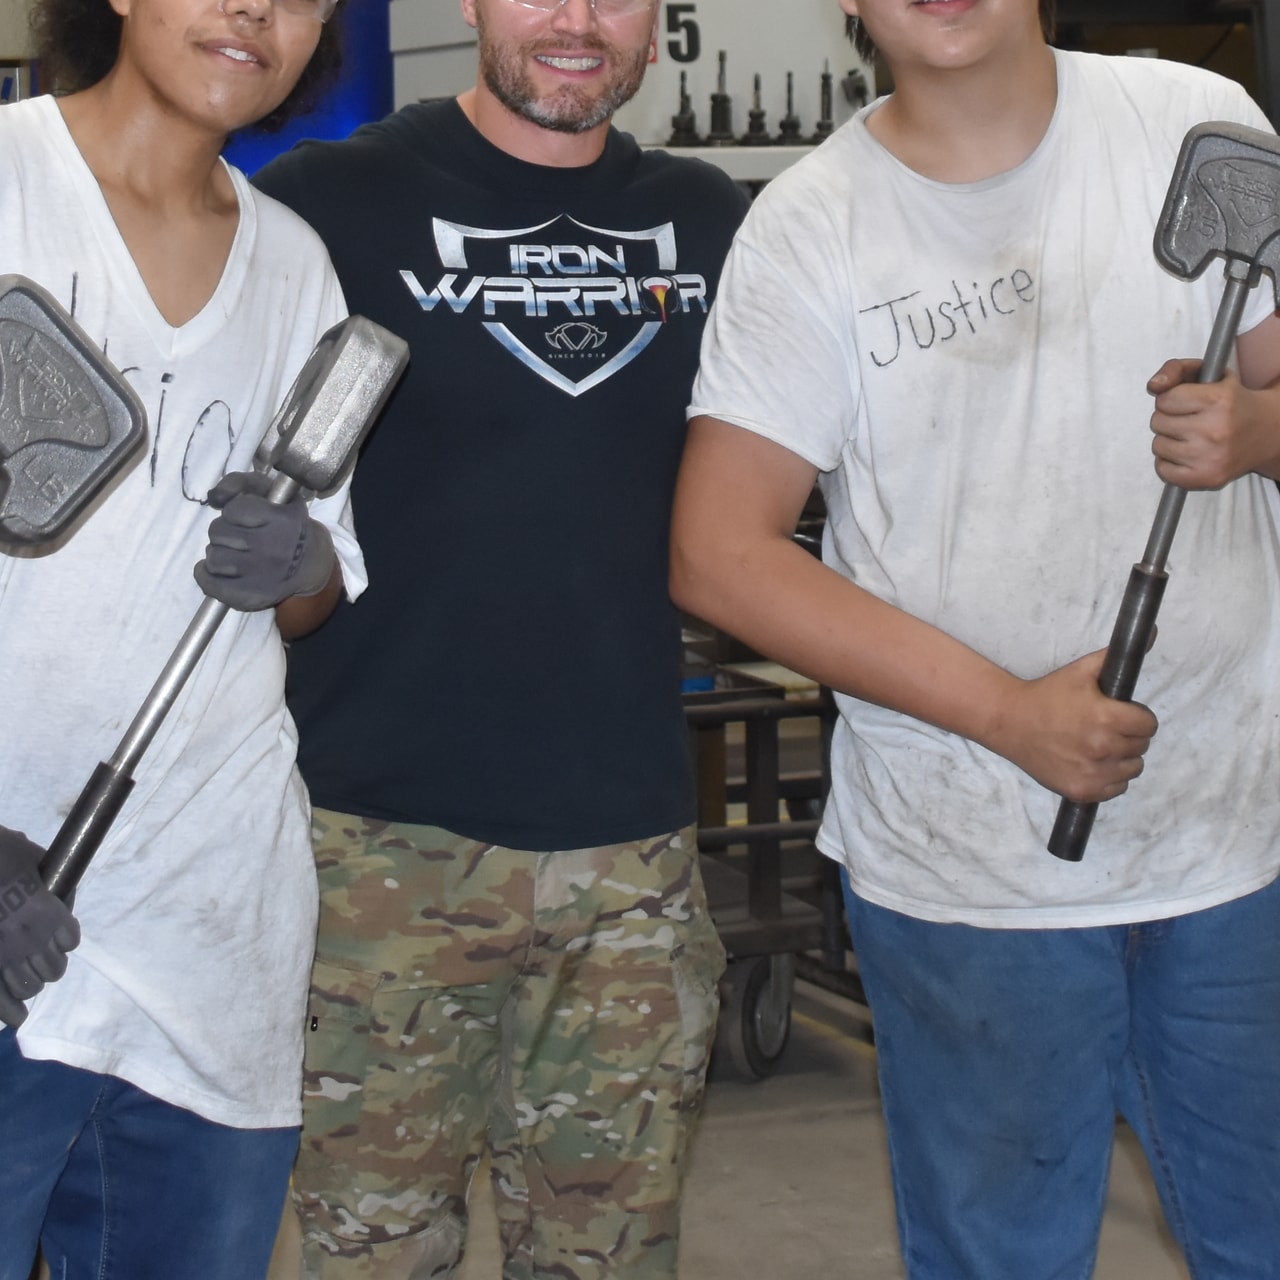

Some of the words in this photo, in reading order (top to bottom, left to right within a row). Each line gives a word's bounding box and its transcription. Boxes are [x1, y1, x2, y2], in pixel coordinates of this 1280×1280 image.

[665, 3, 701, 63] 5
[509, 244, 627, 275] IRON
[399, 269, 708, 319] WARRIOR
[859, 267, 1037, 368] Justice
[17, 454, 72, 507] LB
